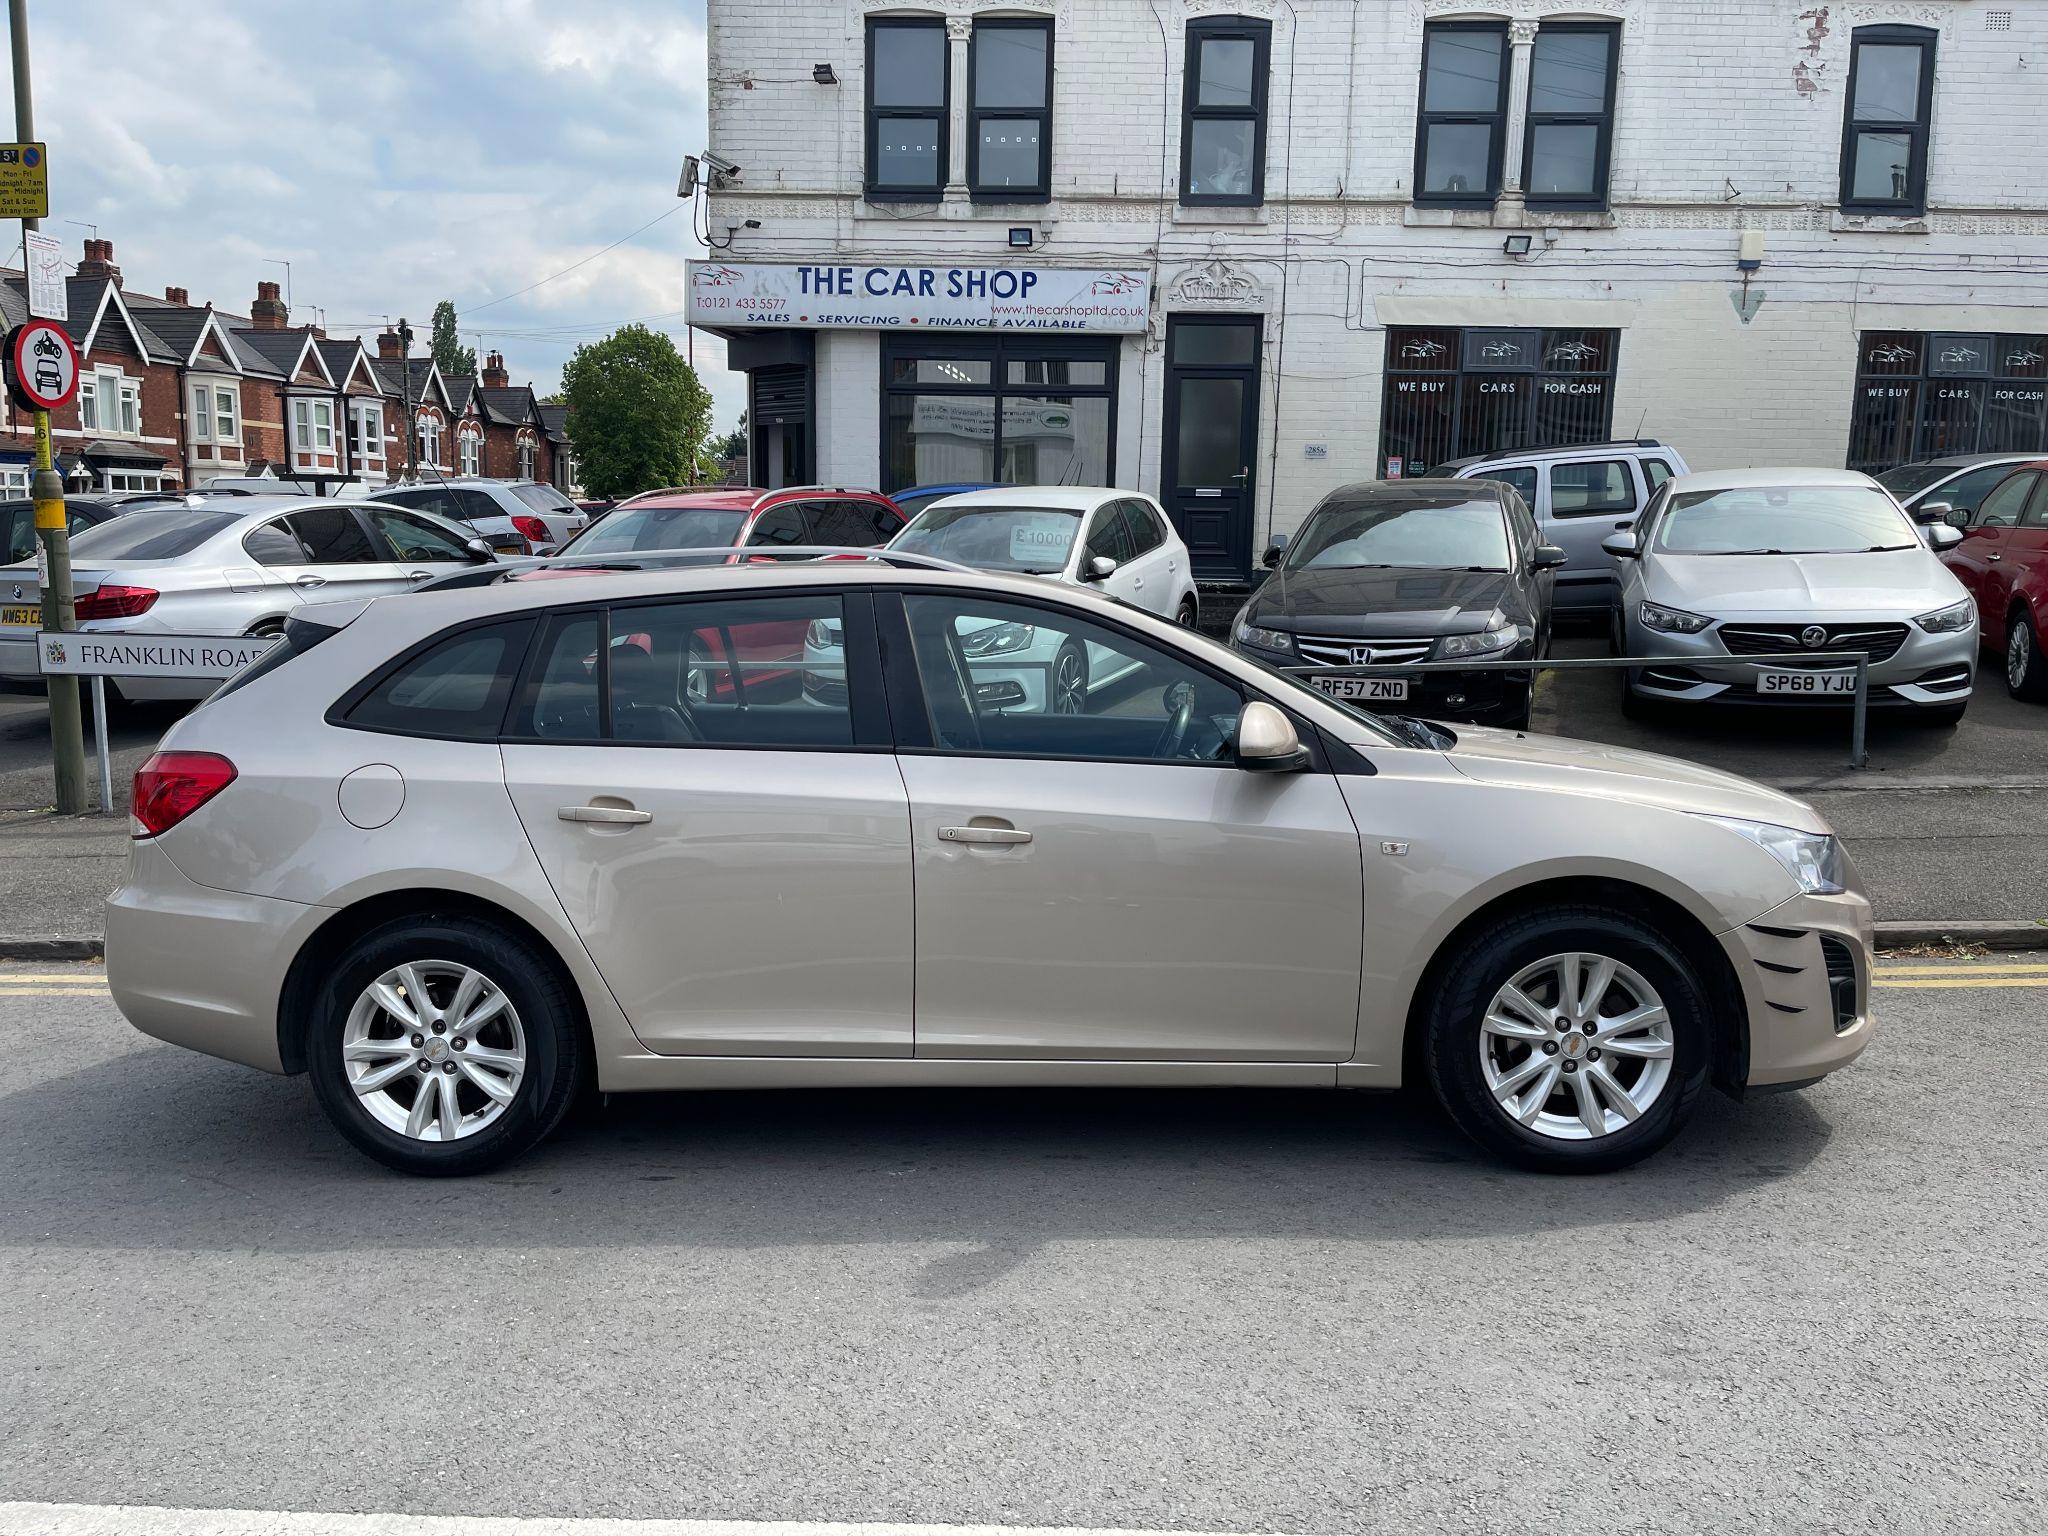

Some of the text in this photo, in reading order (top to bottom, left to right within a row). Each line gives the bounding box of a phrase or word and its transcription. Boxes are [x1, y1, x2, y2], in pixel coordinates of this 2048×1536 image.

[797, 266, 853, 295] THE
[864, 267, 936, 297] CAR
[946, 269, 1038, 299] SHOP
[696, 297, 787, 310] T:0121 433 5577
[990, 304, 1144, 318] www.thecarshopltd.co.uk
[747, 313, 1087, 329] SALES SERVICING FINANCE AVAILABLE
[1398, 382, 1601, 394] WE BUY CARS FOR CASH
[1867, 388, 2044, 400] WE BUY CARS FOR CASH
[2, 609, 28, 624] MW63
[80, 645, 195, 666] FRANKLIN
[1321, 679, 1403, 698] RF57 ZND
[1765, 675, 1857, 692] SP68 YJU
